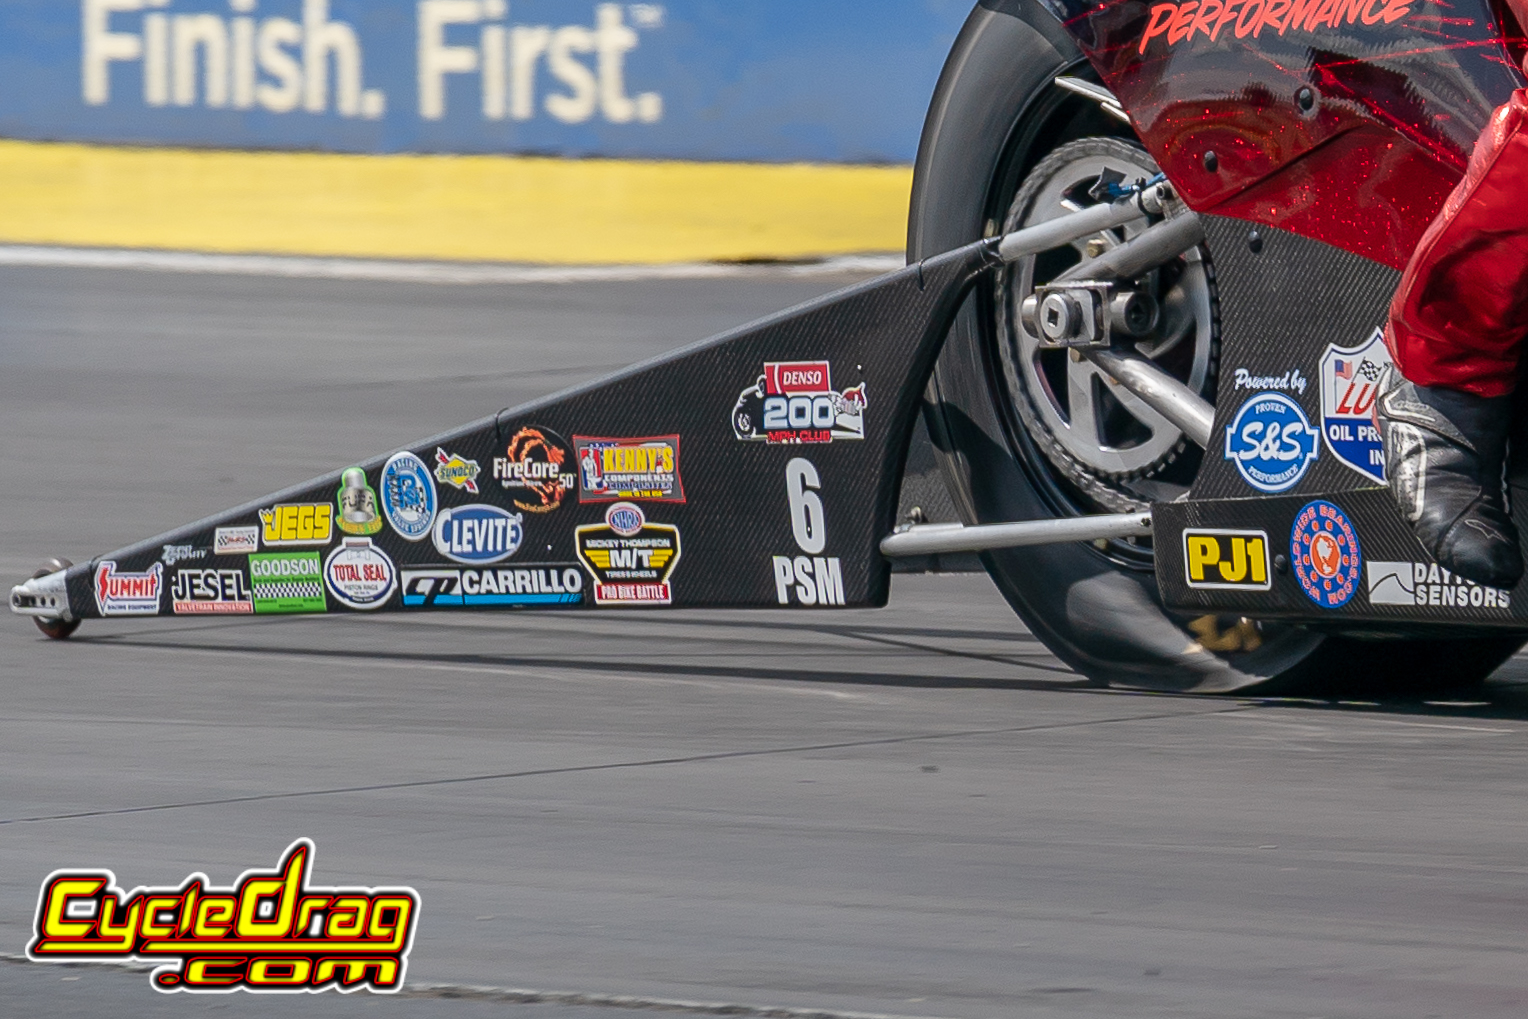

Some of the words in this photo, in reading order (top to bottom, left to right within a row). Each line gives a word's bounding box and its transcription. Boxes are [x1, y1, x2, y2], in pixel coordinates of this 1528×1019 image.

[783, 369, 822, 386] DENSO
[1235, 368, 1290, 390] Powered
[1291, 369, 1306, 395] by
[763, 396, 834, 429] 200
[1255, 402, 1286, 414] PROVEN
[768, 431, 796, 441] MPH
[799, 430, 831, 441] CLUB
[1239, 421, 1303, 461] S&S
[1329, 425, 1354, 442] OIL
[1357, 426, 1382, 442] PR
[440, 465, 478, 479] SUNOCO
[603, 446, 674, 473] KENNY'S
[493, 457, 559, 479] FireCore
[559, 473, 573, 488] 50
[1247, 463, 1299, 483] PERFORMANCE
[786, 457, 826, 555] 6
[264, 504, 331, 541] JEGS
[611, 511, 640, 529] NHRA
[439, 513, 518, 554] CLEVITE
[585, 538, 619, 548] MICKEY
[620, 538, 671, 548] THOMPSON
[251, 558, 319, 577] GOODSON
[609, 548, 654, 570] M/T
[1187, 536, 1267, 582] PJ1
[99, 566, 158, 602] SUMMIT
[333, 564, 360, 582] TOTAL
[362, 563, 387, 581] SEAL
[461, 568, 582, 595] CARRILLO
[772, 555, 846, 606] PSM
[173, 571, 250, 601] JESEL
[601, 584, 617, 600] PRO
[637, 583, 666, 599] BATTLE
[1415, 585, 1511, 609] SENSORS
